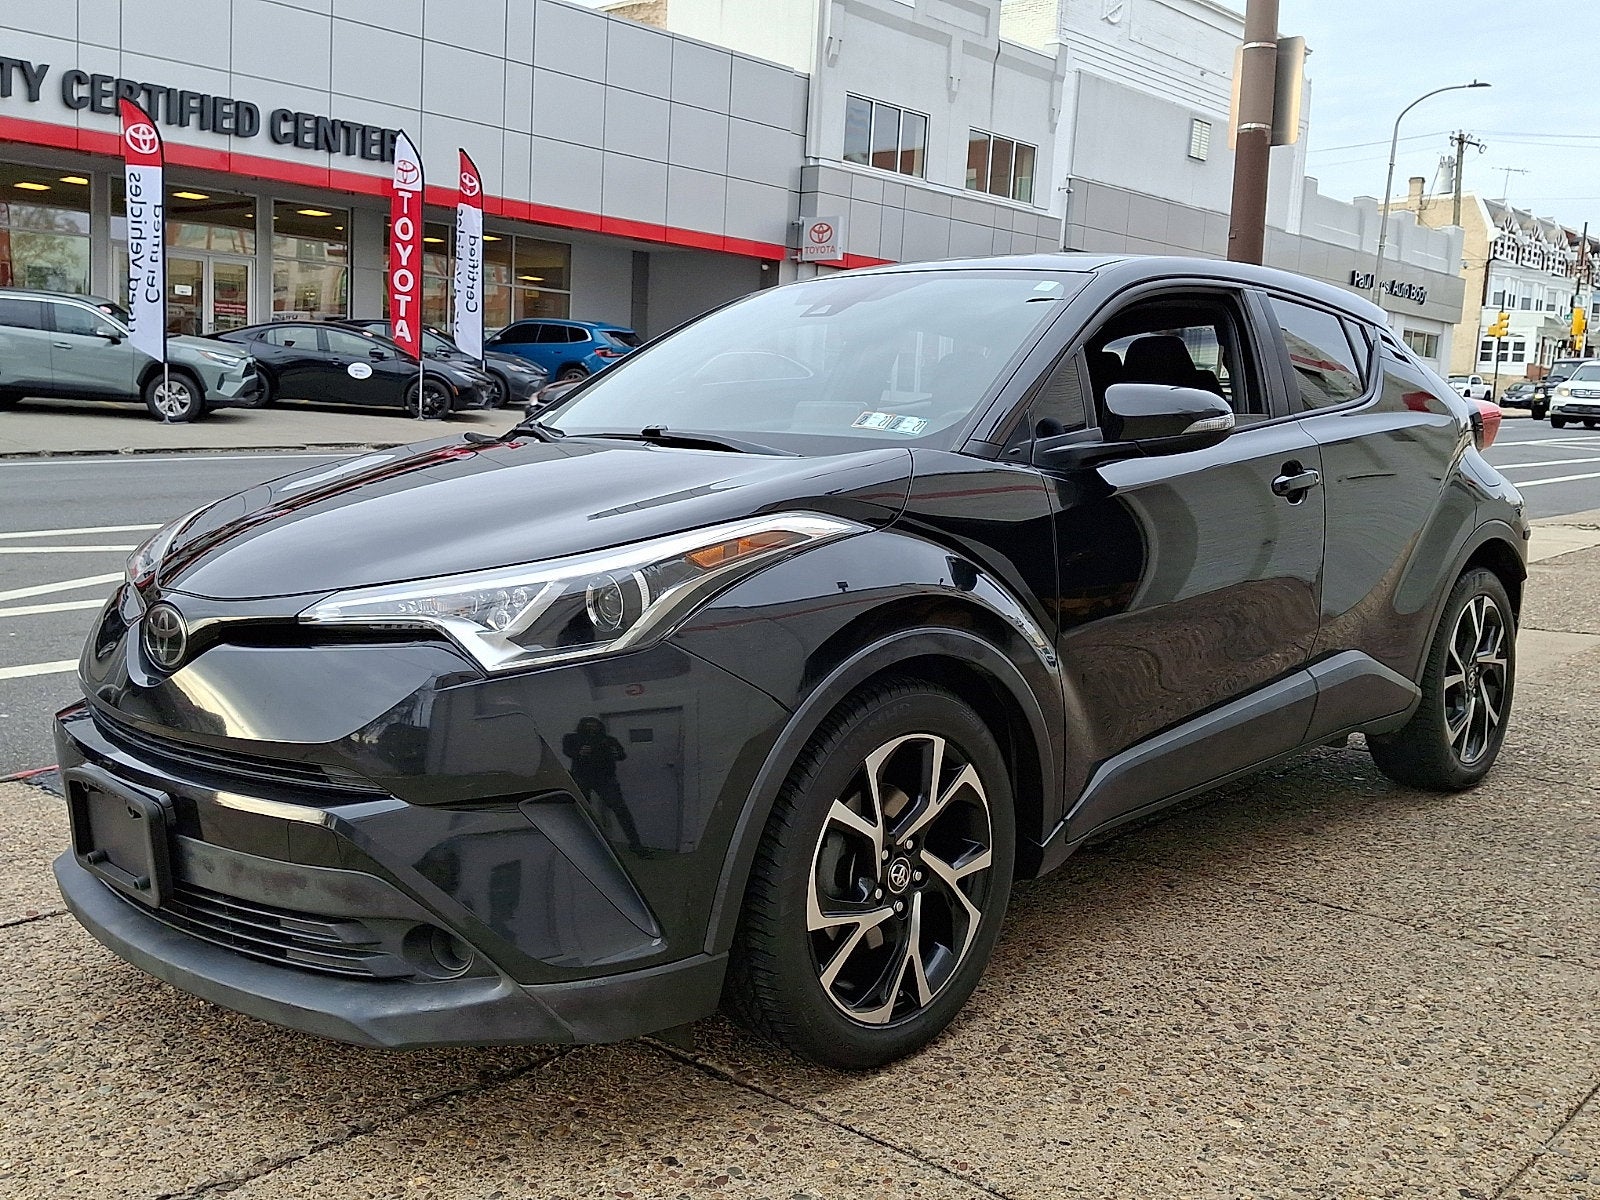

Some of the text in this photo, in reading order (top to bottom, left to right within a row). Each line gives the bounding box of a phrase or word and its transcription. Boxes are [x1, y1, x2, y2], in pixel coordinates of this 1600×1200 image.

[62, 69, 261, 138] CERTIFIED
[392, 190, 415, 343] TOYOTA
[805, 245, 836, 255] TOYOTA
